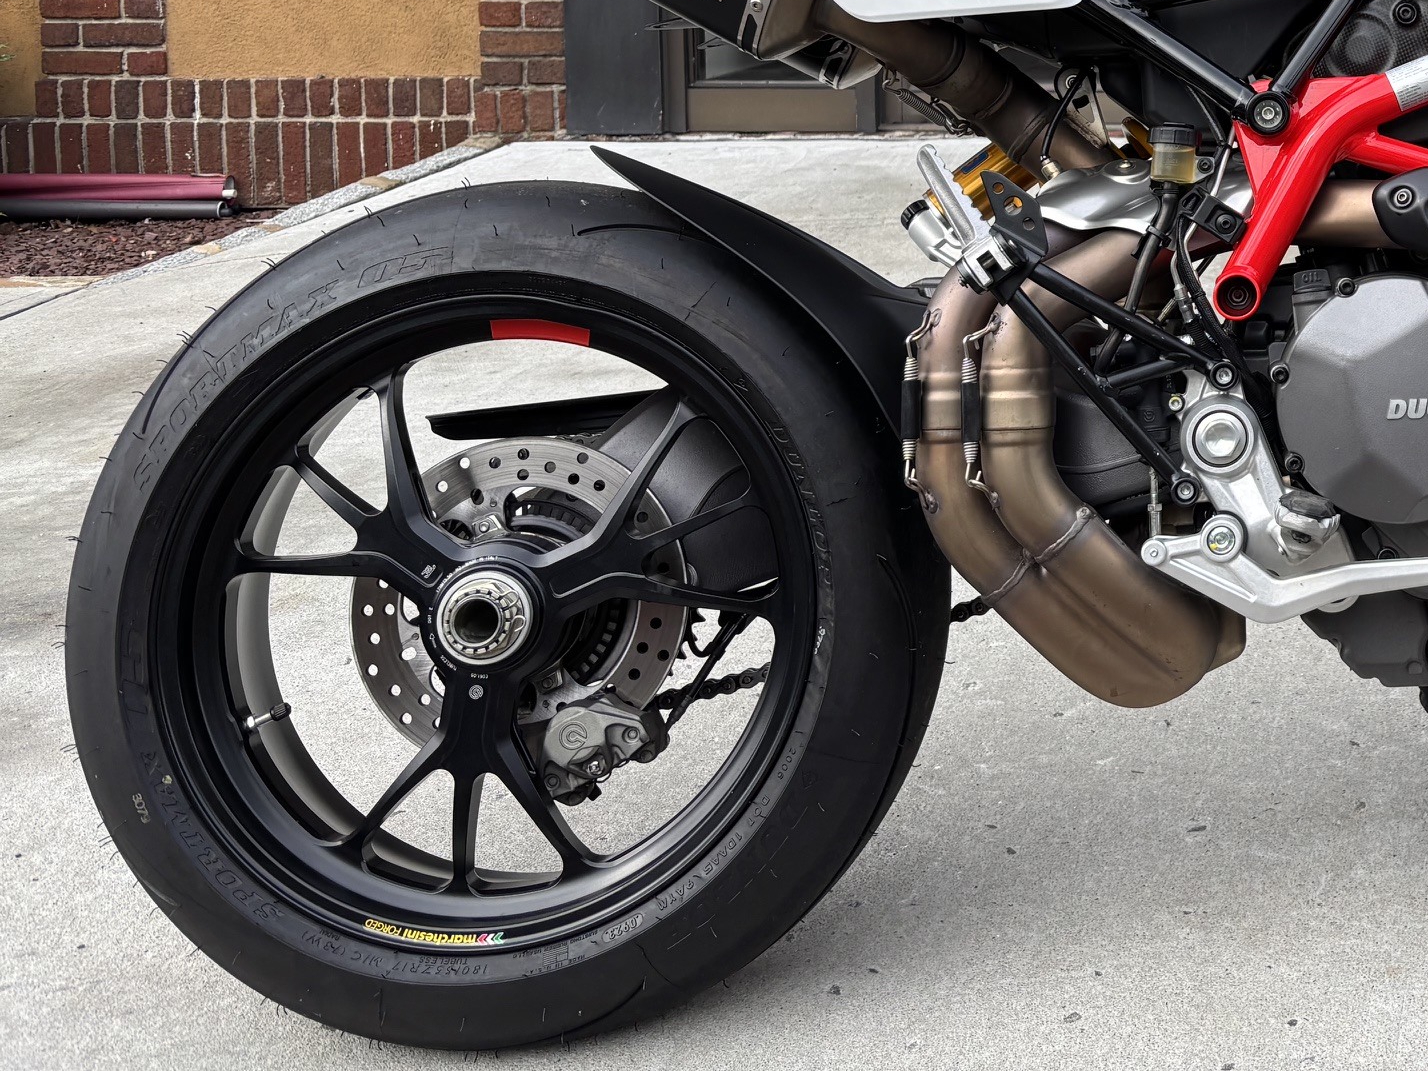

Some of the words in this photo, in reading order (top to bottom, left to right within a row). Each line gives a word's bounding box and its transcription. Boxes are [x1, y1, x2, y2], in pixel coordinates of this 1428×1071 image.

[1301, 271, 1322, 283] OIL
[133, 279, 339, 493] SPORTMAX
[746, 794, 771, 828] DOT
[364, 918, 402, 936] FORGED
[403, 928, 477, 945] marchesini
[418, 956, 468, 966] TUBELESS
